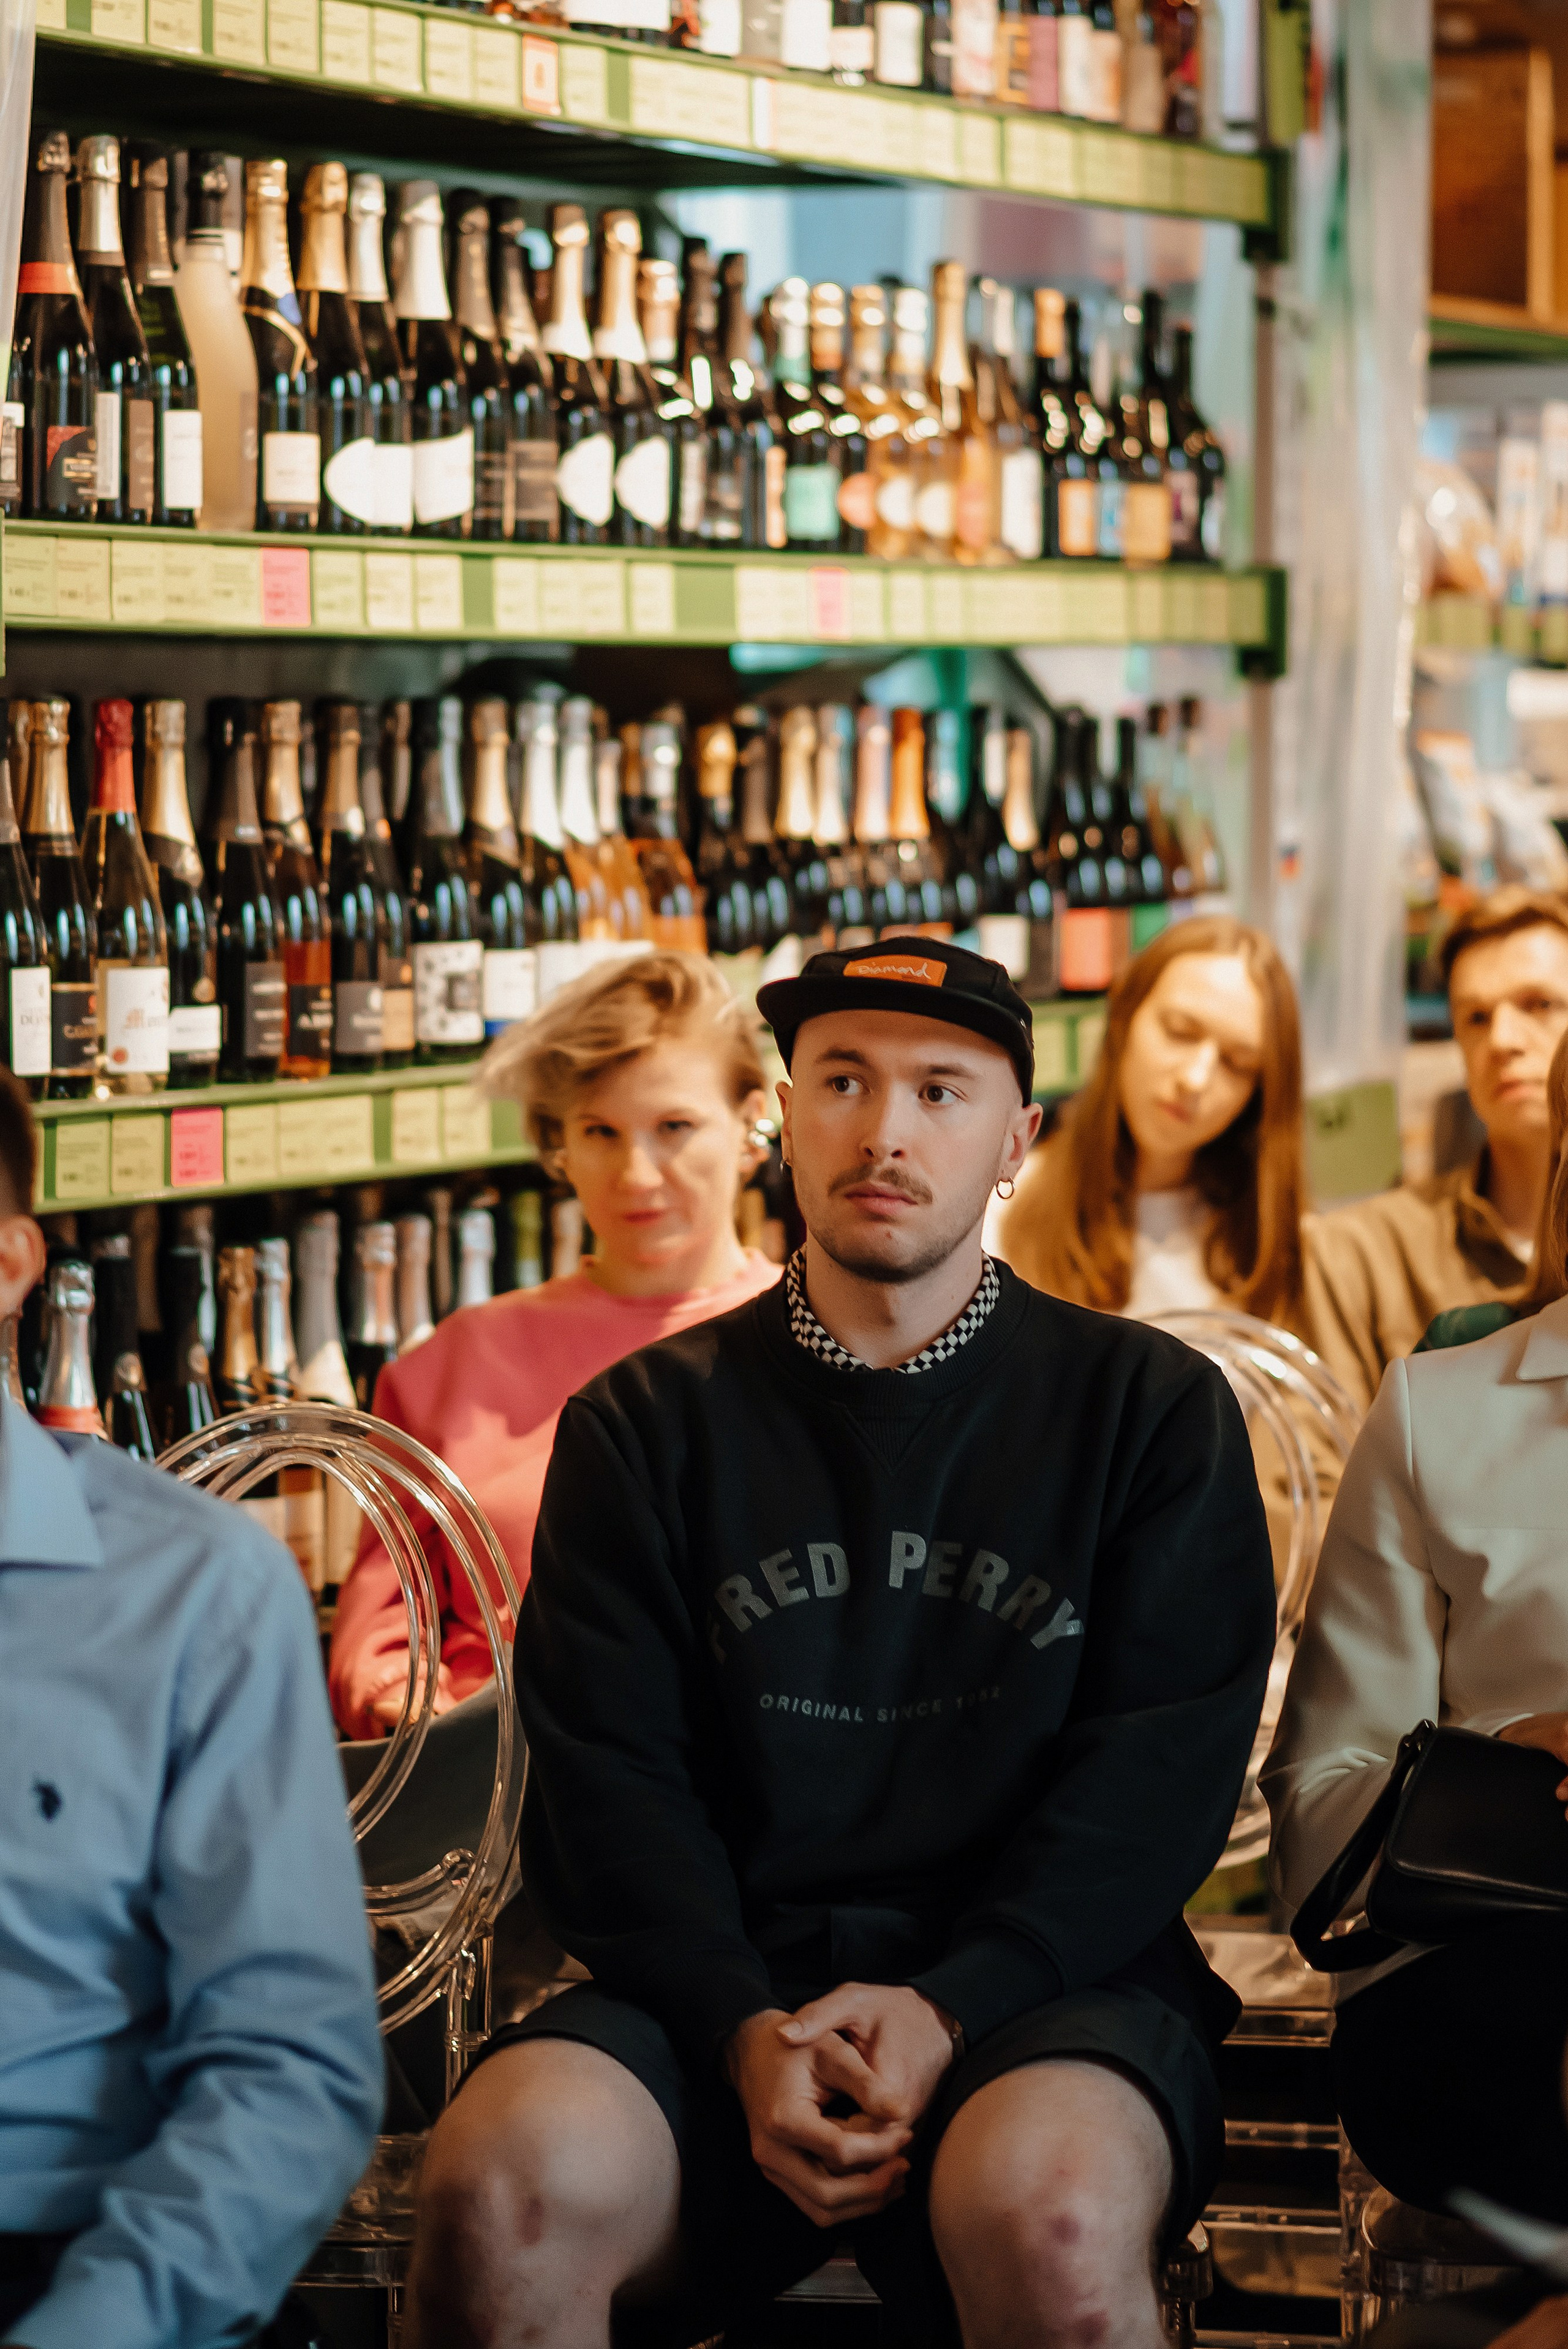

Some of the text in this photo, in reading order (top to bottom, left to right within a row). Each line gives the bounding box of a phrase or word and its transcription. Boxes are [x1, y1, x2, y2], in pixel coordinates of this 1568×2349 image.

[858, 961, 932, 980] Diamond
[889, 1531, 1085, 1651] PERRY
[759, 1692, 864, 1723] ORIGINAL
[876, 1699, 943, 1723] SINCE
